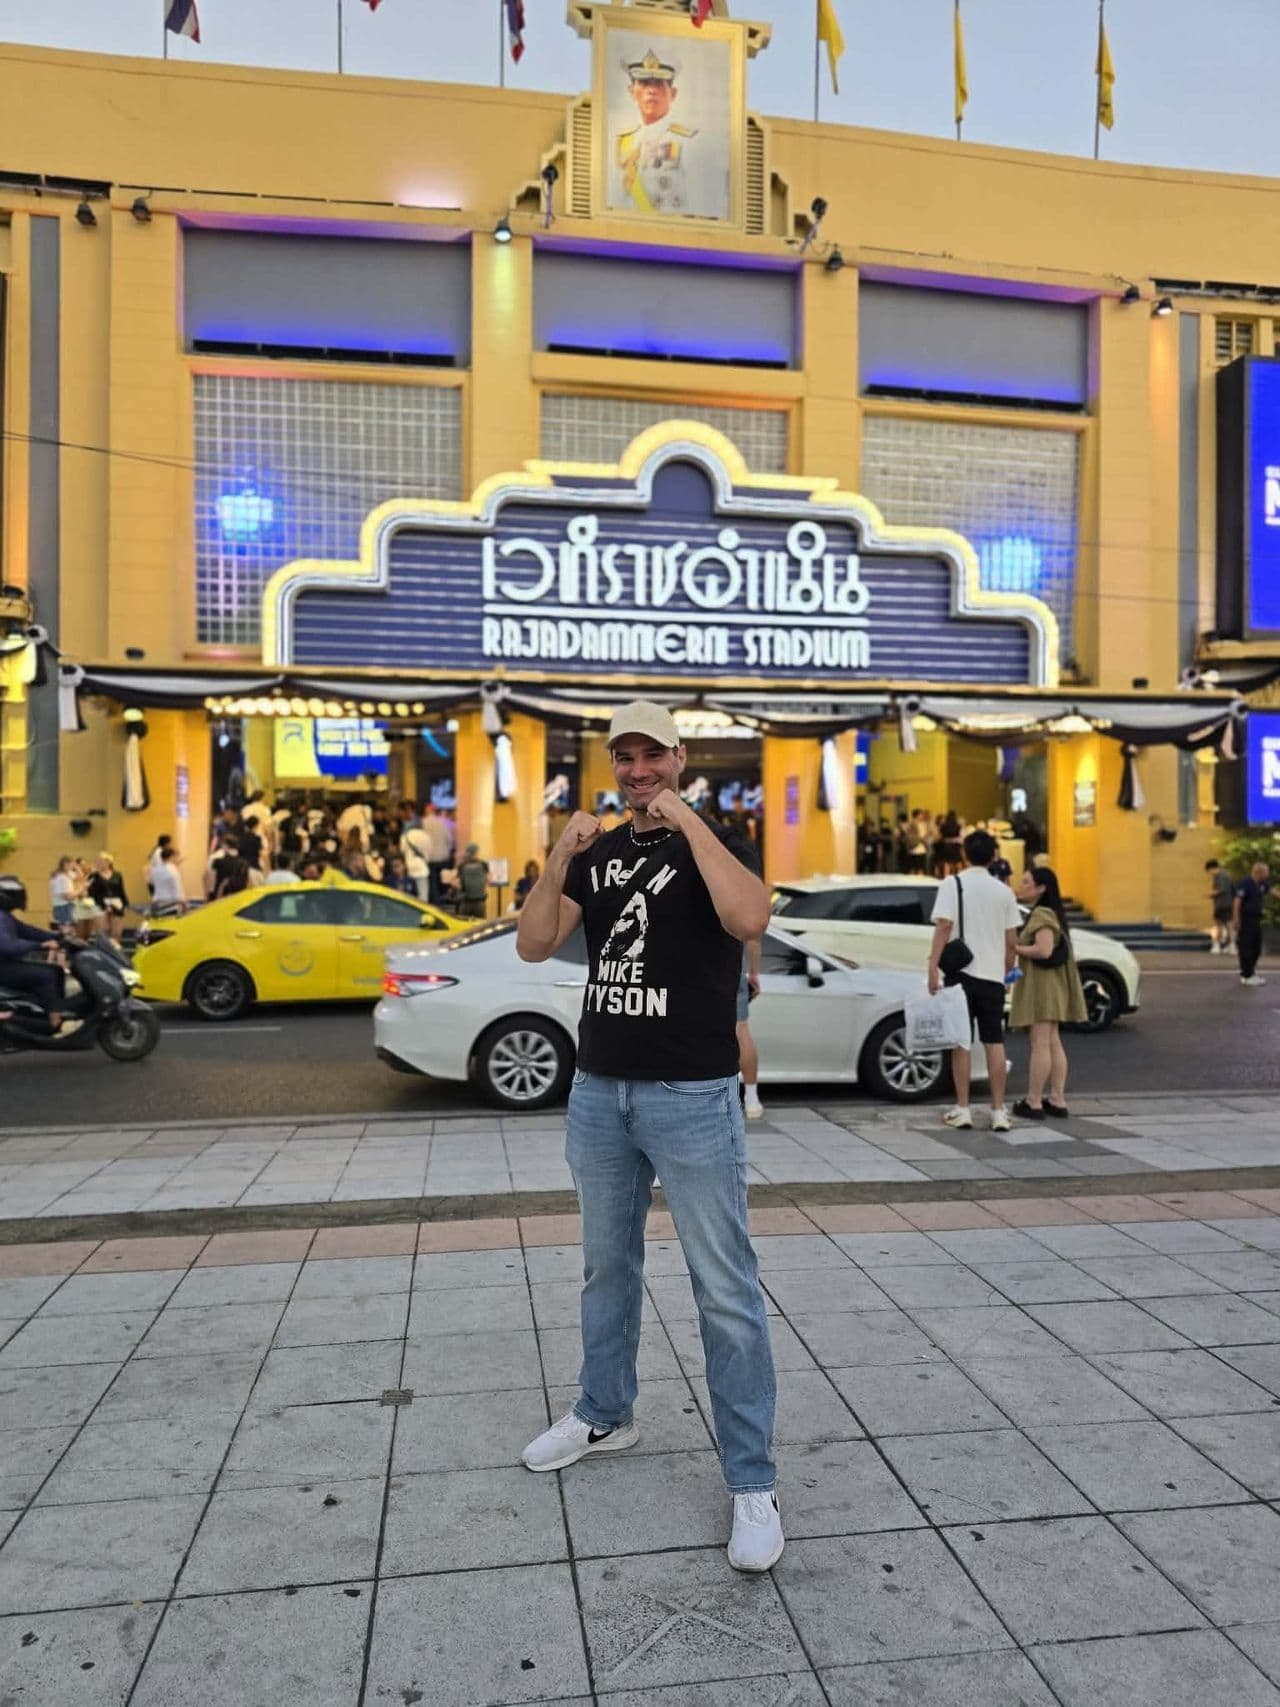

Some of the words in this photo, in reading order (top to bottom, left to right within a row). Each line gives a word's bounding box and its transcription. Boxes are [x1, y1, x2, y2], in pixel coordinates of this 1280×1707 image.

[482, 514, 870, 614] เวทีราชดำเนิน
[482, 616, 729, 665] RAJADAMNERN
[743, 627, 870, 669] STADIUM
[597, 959, 644, 984] MIKE
[586, 983, 668, 1017] TYSON
